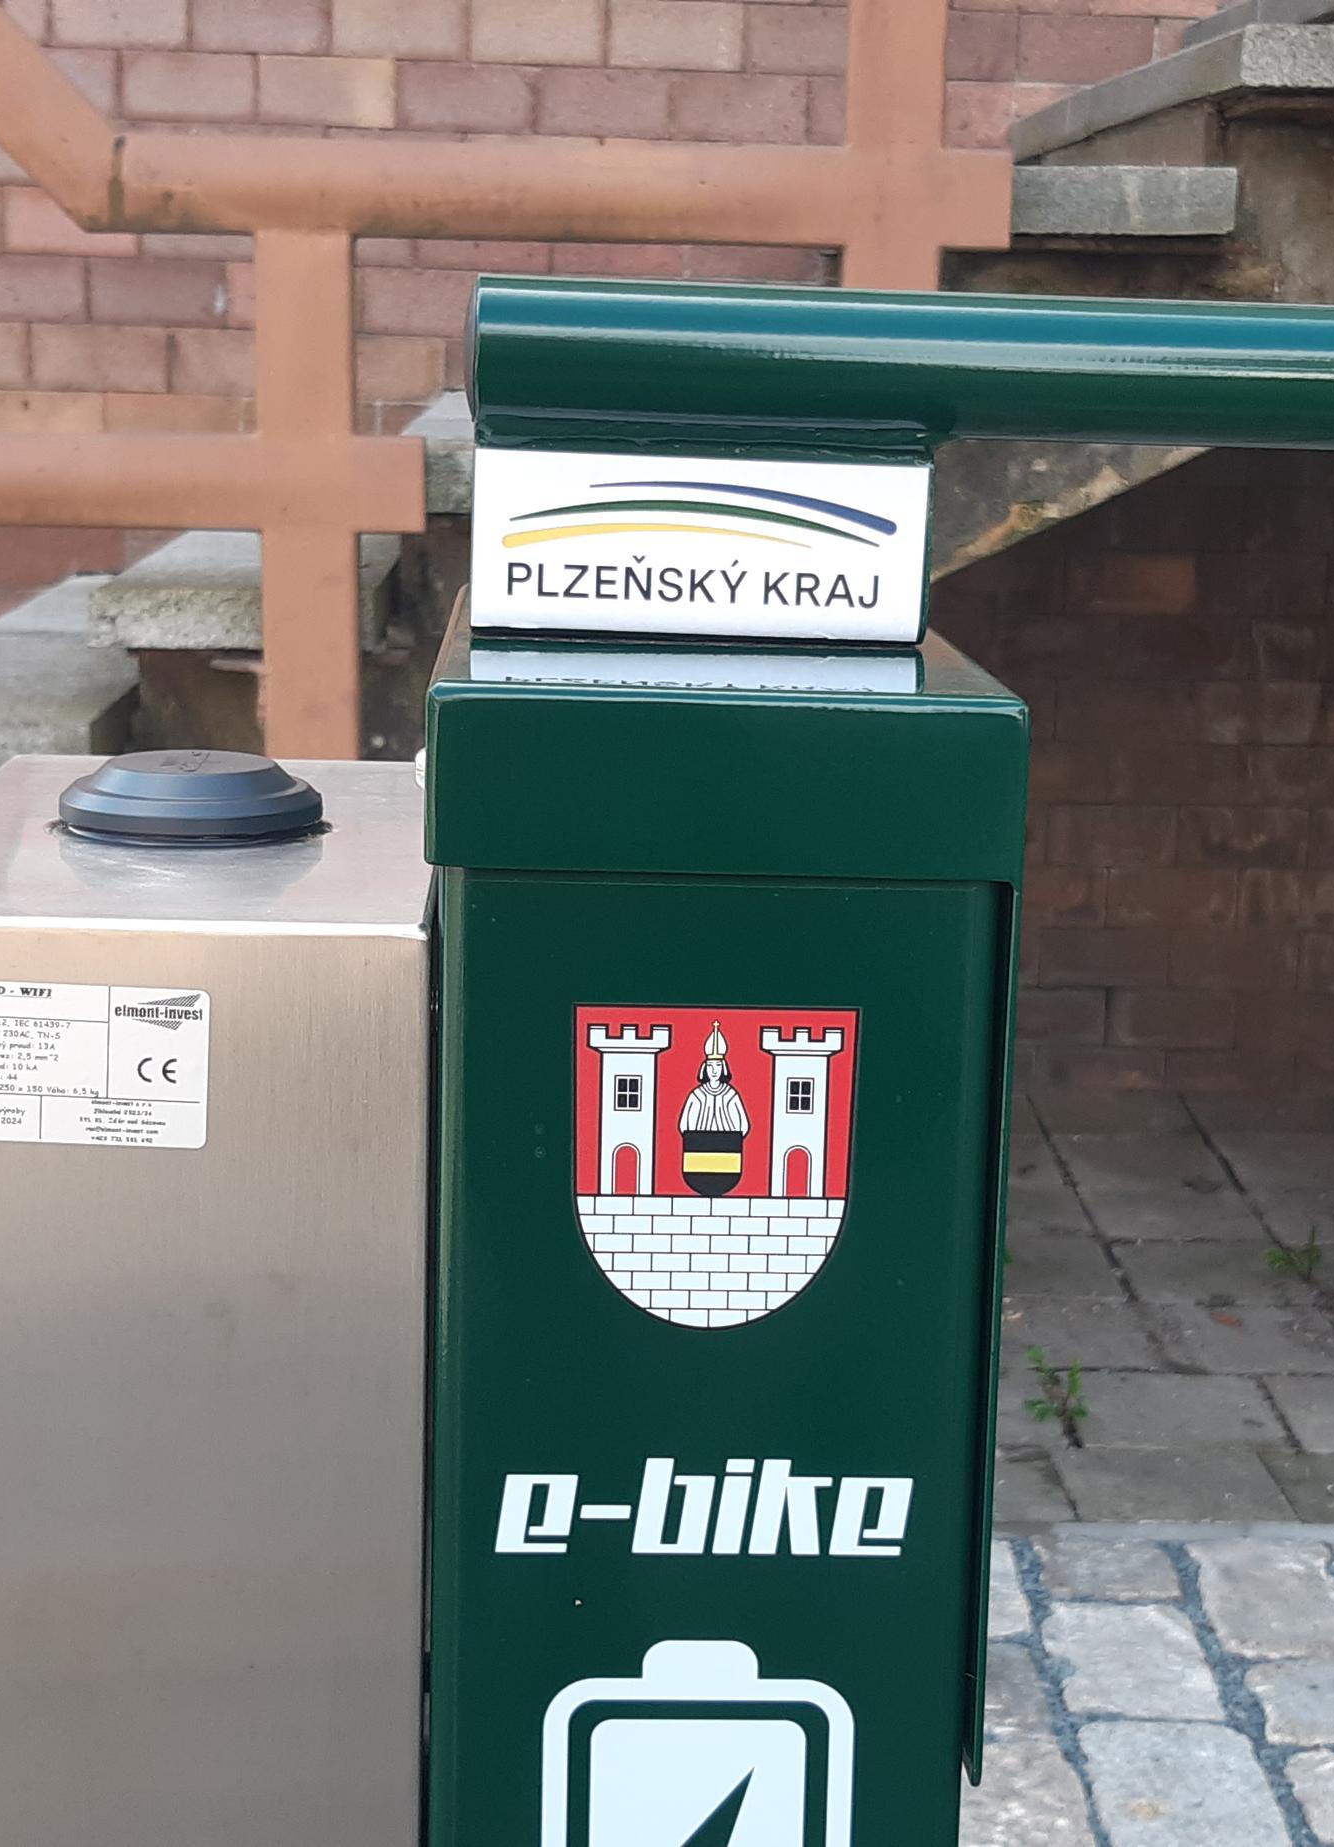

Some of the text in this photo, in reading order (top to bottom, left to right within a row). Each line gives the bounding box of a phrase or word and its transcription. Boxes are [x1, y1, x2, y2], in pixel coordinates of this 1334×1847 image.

[507, 556, 880, 609] PLZEŇSKÝ KRAJ
[115, 1005, 202, 1020] elmont-invest
[494, 1458, 913, 1556] e-bike
